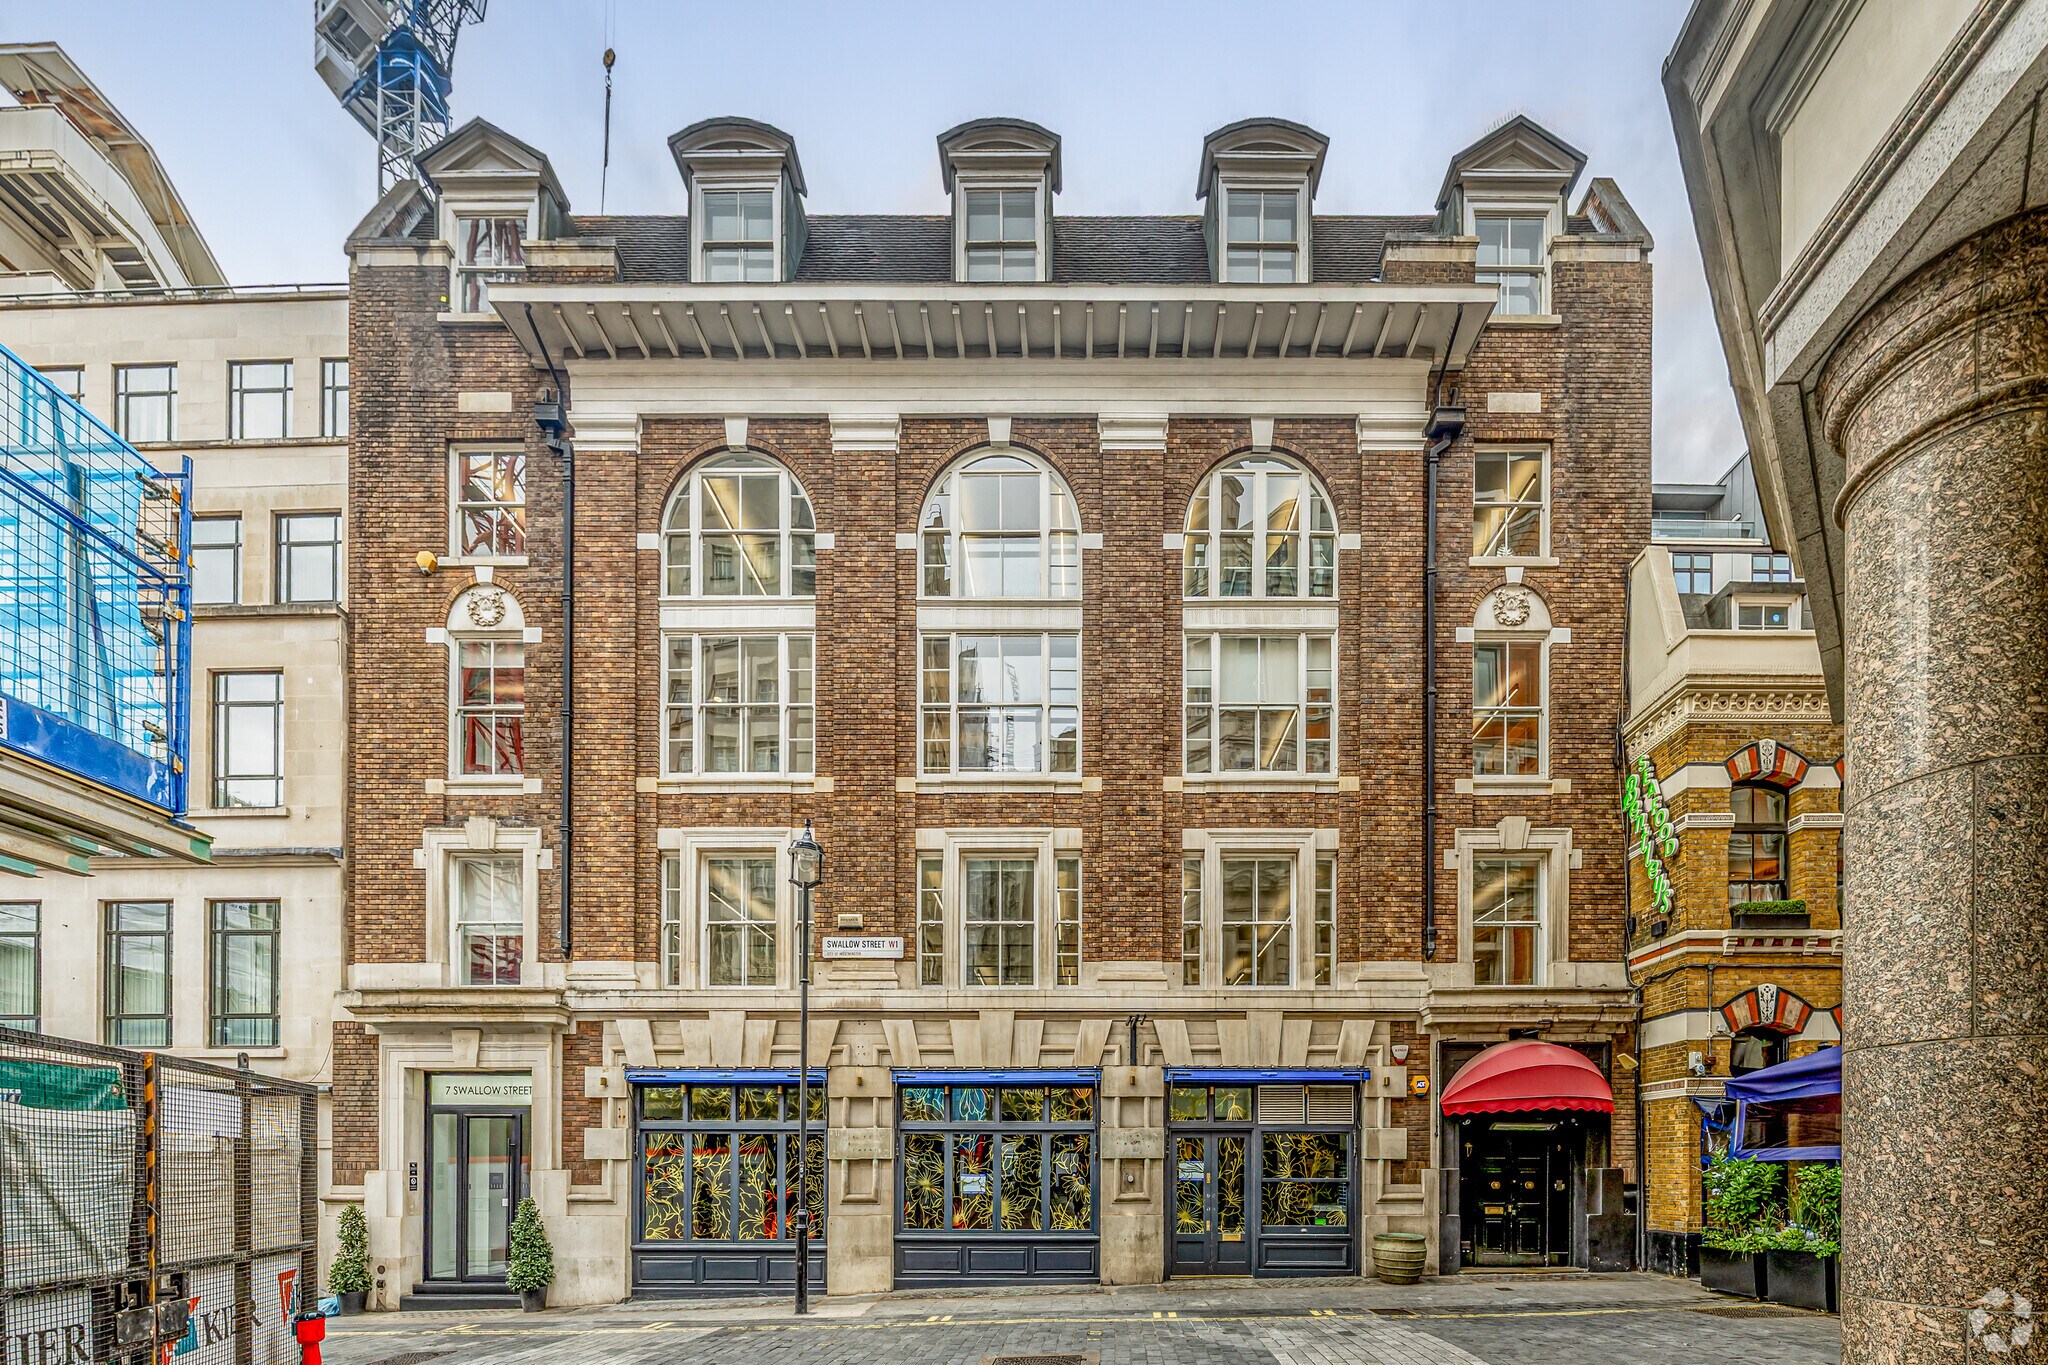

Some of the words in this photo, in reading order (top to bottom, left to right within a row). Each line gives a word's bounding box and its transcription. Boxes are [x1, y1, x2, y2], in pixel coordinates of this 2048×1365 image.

[1638, 755, 1678, 857] SEAFOOD
[826, 940, 860, 948] SWALLOW
[861, 940, 885, 948] STREET
[888, 940, 898, 948] W1
[445, 1086, 451, 1095] 7
[453, 1086, 501, 1095] SWALLOW
[503, 1086, 532, 1095] STREET
[3, 1324, 90, 1365] IER
